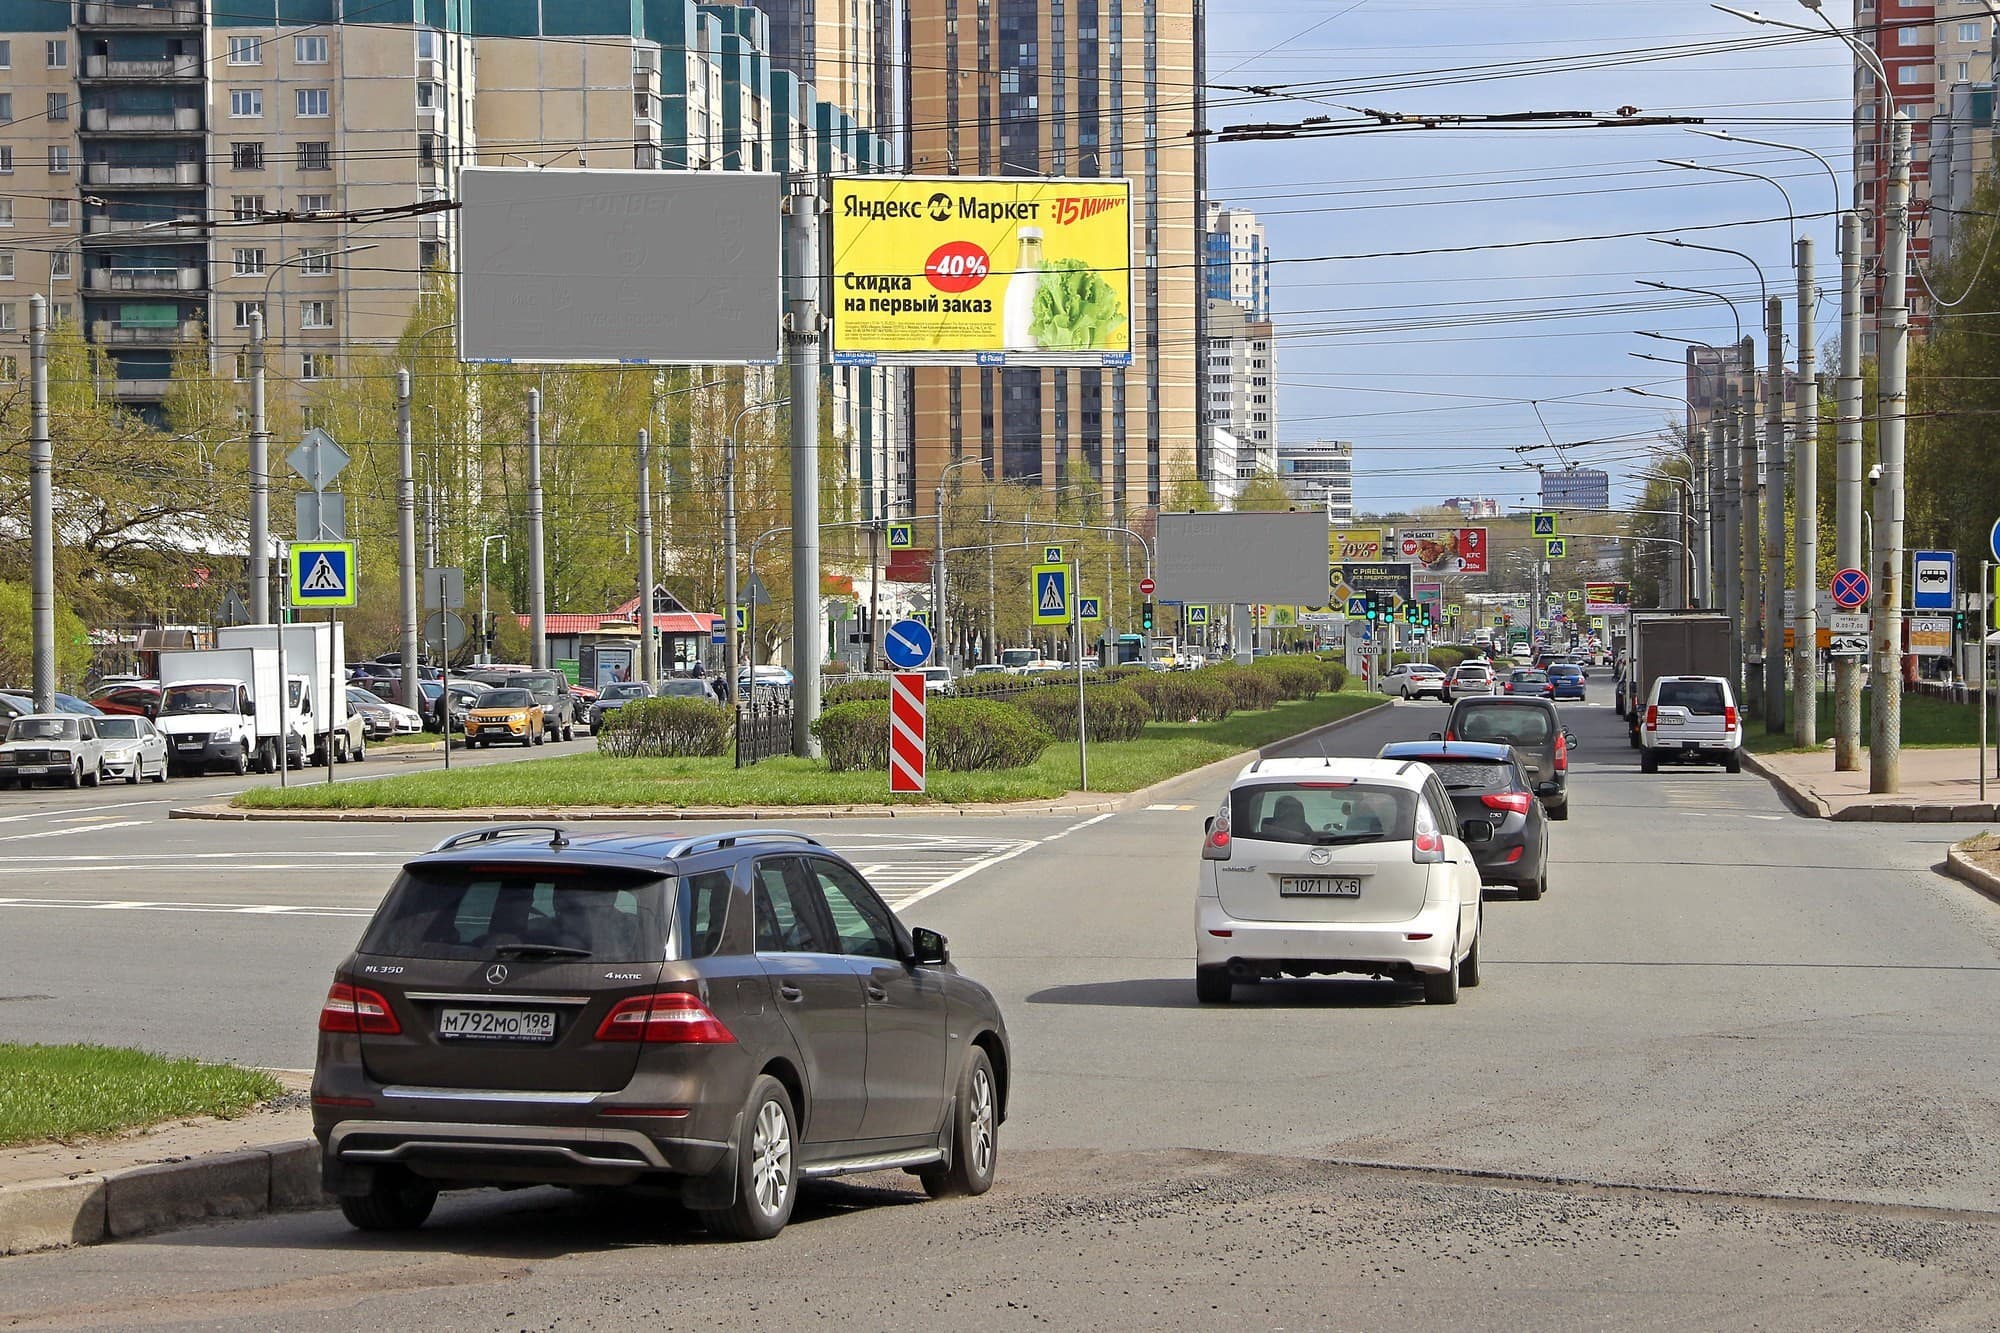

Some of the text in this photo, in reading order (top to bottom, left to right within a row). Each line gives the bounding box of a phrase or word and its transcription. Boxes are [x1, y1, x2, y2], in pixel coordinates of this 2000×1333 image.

[843, 194, 1040, 223] Яндекс Маркет
[844, 272, 912, 293] Скидка
[844, 294, 992, 316] на первый заказ
[1294, 879, 1321, 893] 1071
[365, 965, 404, 974] ML 350
[522, 1013, 550, 1029] 198
